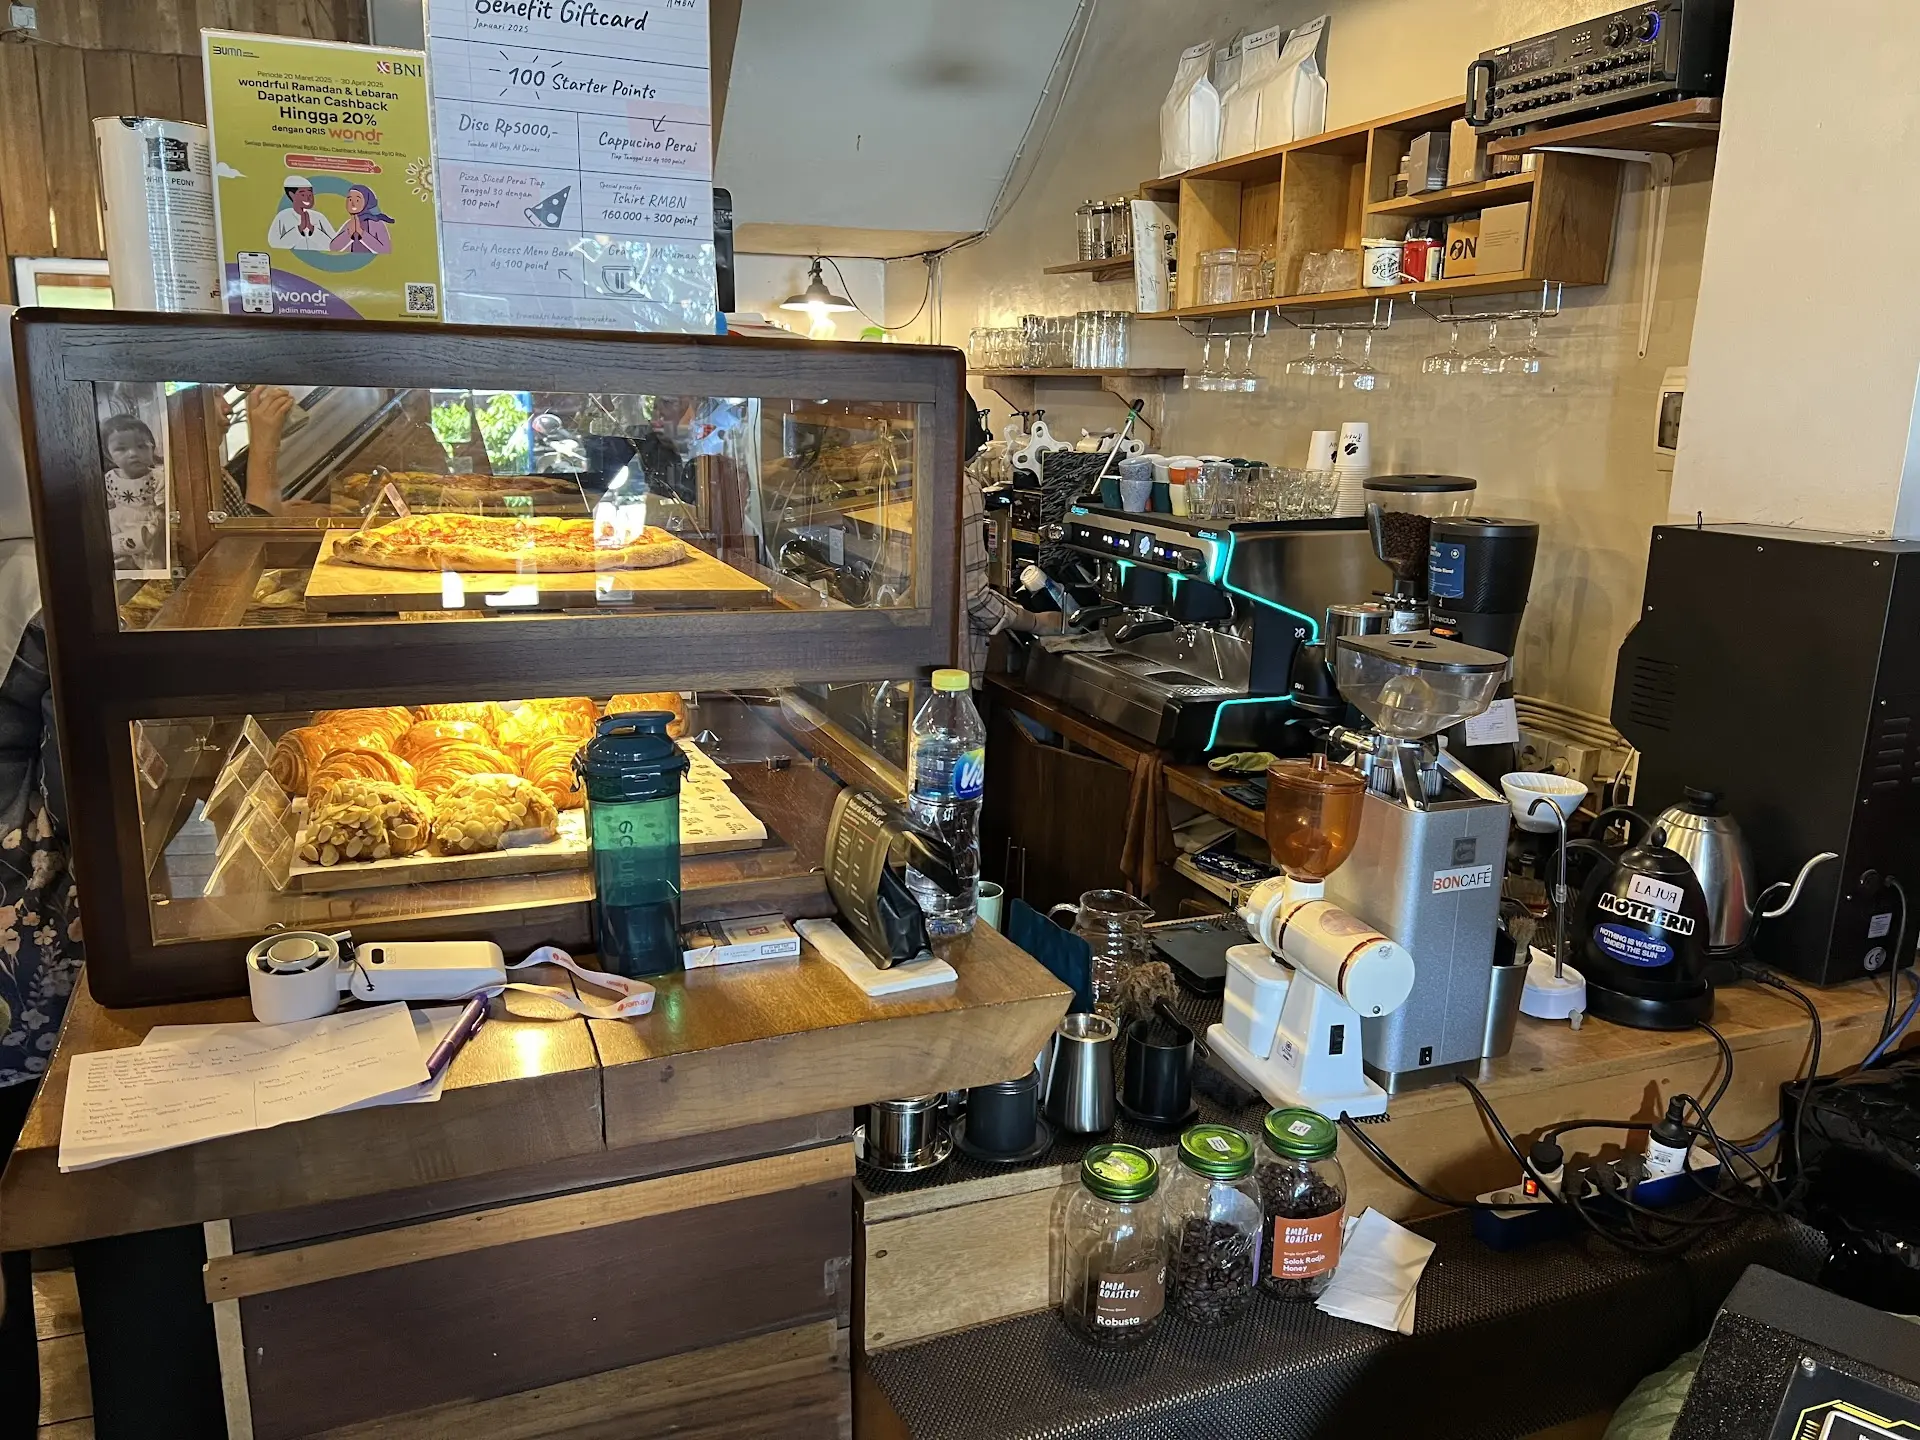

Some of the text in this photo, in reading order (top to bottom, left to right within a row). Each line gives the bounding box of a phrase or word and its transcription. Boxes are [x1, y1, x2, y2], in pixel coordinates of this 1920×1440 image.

[560, 0, 649, 31] Giftcard
[472, 18, 529, 33] Januari 2025
[393, 62, 422, 78] BNI
[238, 78, 398, 100] wondrful Ramadan & Lebaran
[295, 74, 314, 82] Maret
[367, 80, 384, 88] 2025
[508, 67, 656, 99] 100 Starter Points
[258, 90, 388, 111] Dapatkan Cashback
[280, 106, 377, 126] Hingga 20%
[272, 124, 304, 134] dengan
[328, 128, 383, 142] wondr
[458, 114, 558, 138] Disc Rp5000,-
[598, 131, 698, 153] Cappucino Perai
[171, 178, 194, 187] PEONY
[459, 171, 546, 188] Pizza Sliced Perai Tiap
[460, 184, 532, 199] Tanggal 30 dengan
[462, 198, 500, 210] 100 point
[613, 192, 688, 209] Tshirt RMBN
[602, 209, 642, 221] 160.000
[654, 213, 672, 223] 300
[674, 215, 698, 227] point
[462, 242, 488, 255] Early
[490, 243, 522, 256] Access
[524, 245, 549, 257] Menu
[490, 258, 549, 272] dg 100 point
[275, 290, 330, 303] wondr
[1433, 868, 1492, 890] BONCAFÉ
[1598, 892, 1695, 936] MOTHERN
[1600, 926, 1667, 953] NOTHING IS WASTED
[1603, 936, 1625, 950] UNDER
[1626, 945, 1641, 955] THE
[1642, 950, 1658, 959] SUN
[1284, 1233, 1323, 1244] ROASTERY
[1100, 1289, 1140, 1299] ROASTERY
[1096, 1315, 1140, 1326] Robusta
